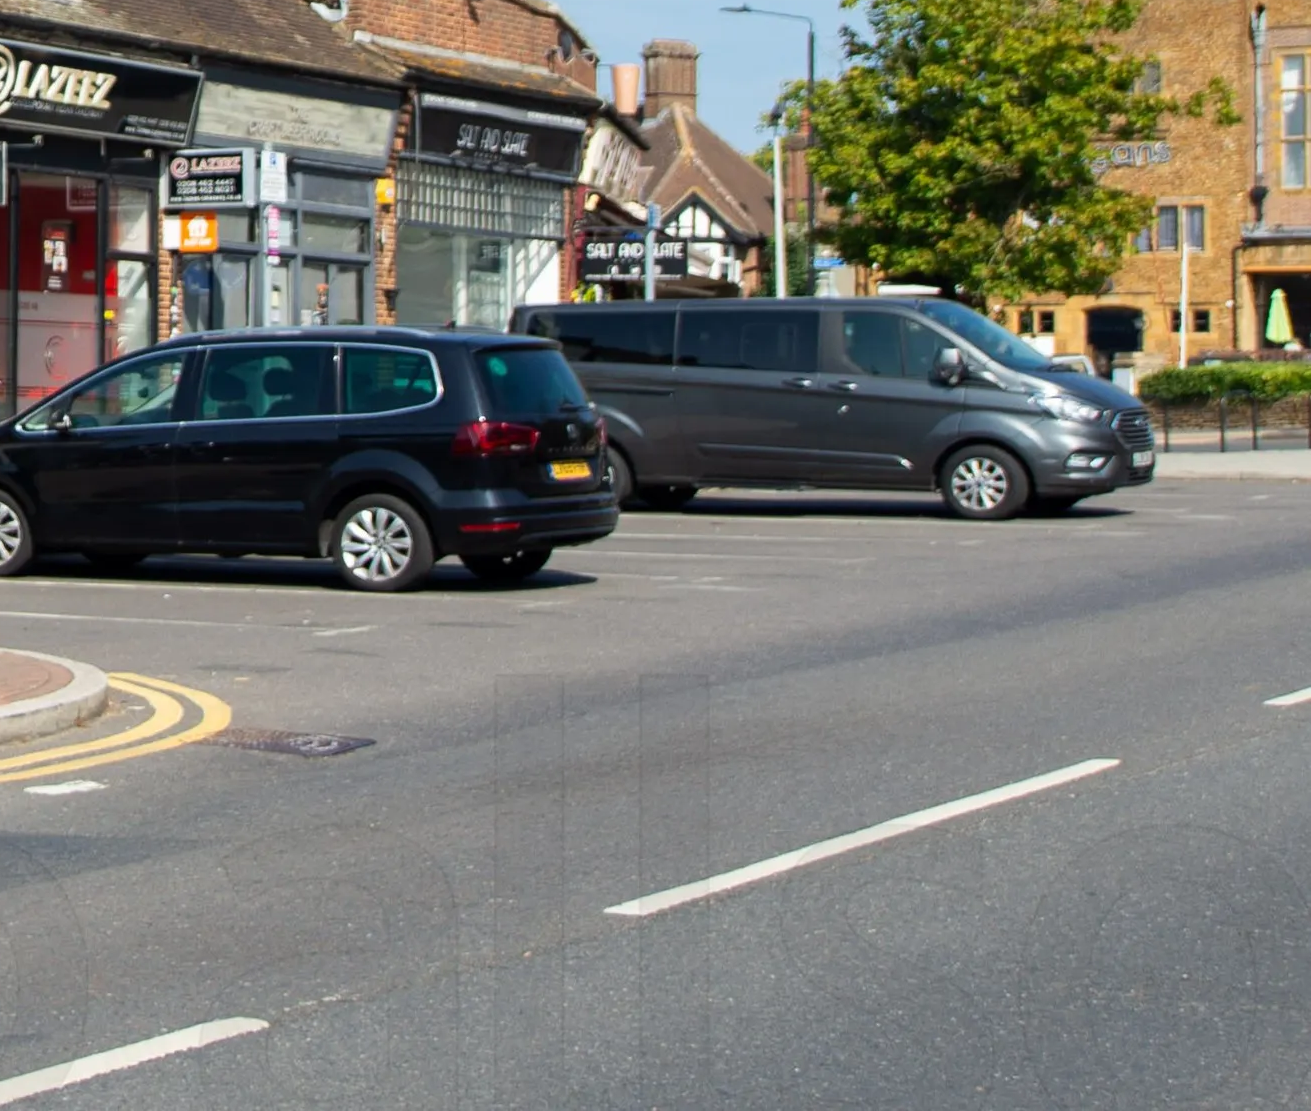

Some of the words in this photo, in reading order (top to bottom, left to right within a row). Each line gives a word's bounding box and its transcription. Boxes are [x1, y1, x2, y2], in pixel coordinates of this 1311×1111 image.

[11, 60, 117, 109] LAZEEZ
[457, 123, 481, 150] SALT
[481, 127, 502, 152] AND
[501, 130, 530, 157] SLATE
[586, 243, 615, 259] SALT
[618, 243, 644, 259] AND
[653, 242, 684, 259] LATE
